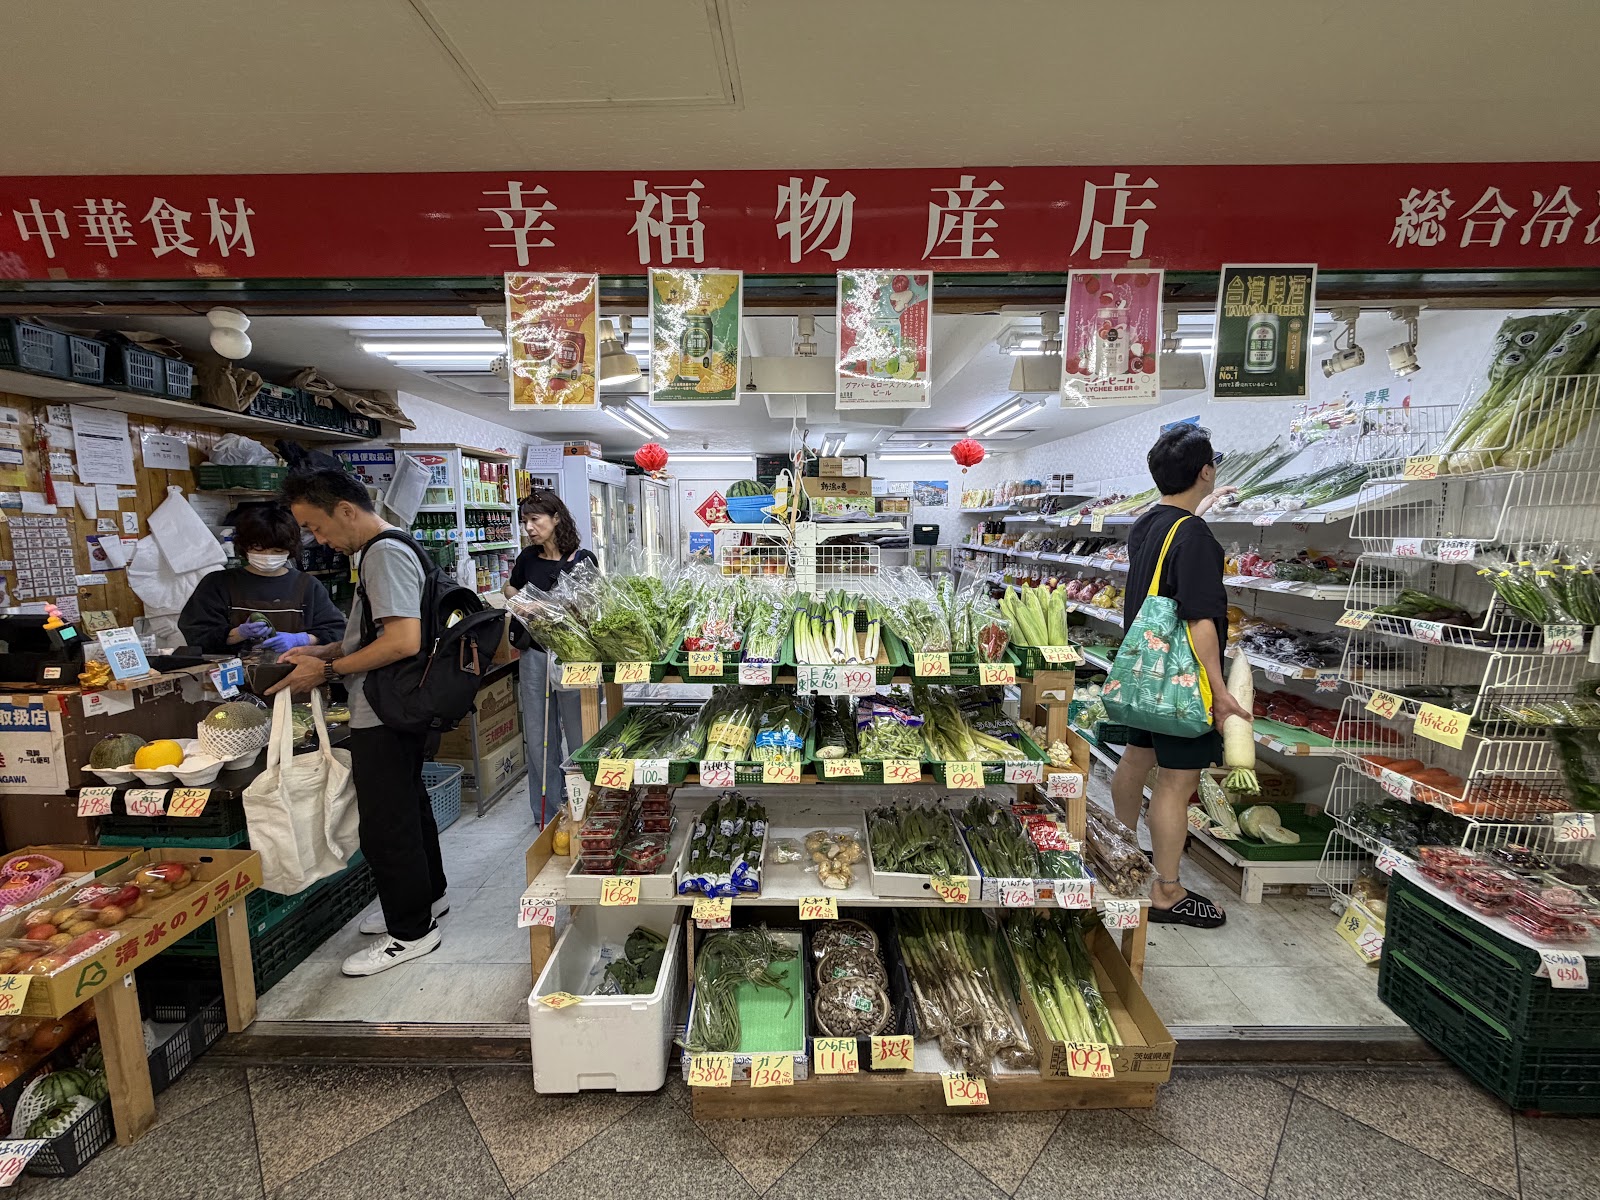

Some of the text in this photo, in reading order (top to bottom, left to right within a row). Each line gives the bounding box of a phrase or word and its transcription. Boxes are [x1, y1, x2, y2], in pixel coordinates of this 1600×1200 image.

[478, 172, 1160, 267] 幸福物産店
[12, 197, 256, 259] 中華食材
[1271, 304, 1305, 316] BEER
[1219, 371, 1238, 380] No.1
[984, 669, 1014, 684] 130円
[0, 709, 47, 726] 取扱店
[1051, 783, 1077, 794] ￥88
[1059, 883, 1084, 895] オクラ
[115, 871, 251, 967] 清水のプラム
[816, 1039, 856, 1054] ひらたけ
